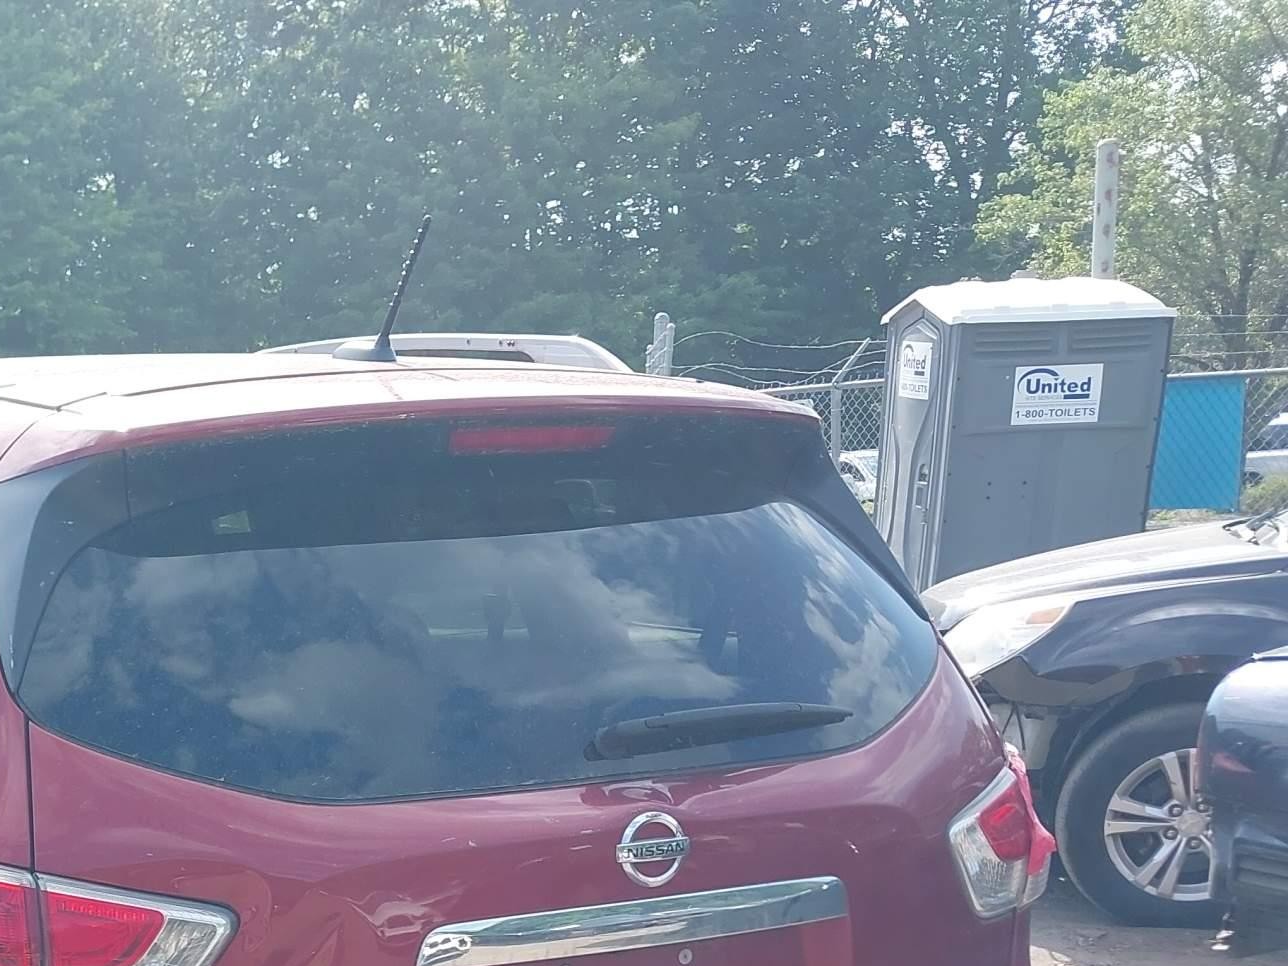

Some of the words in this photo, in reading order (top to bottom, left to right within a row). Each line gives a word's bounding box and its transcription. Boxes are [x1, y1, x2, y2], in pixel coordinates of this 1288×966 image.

[1025, 376, 1092, 395] United
[1015, 407, 1097, 419] 1-800-TOILETS
[626, 842, 685, 858] NISSAN
